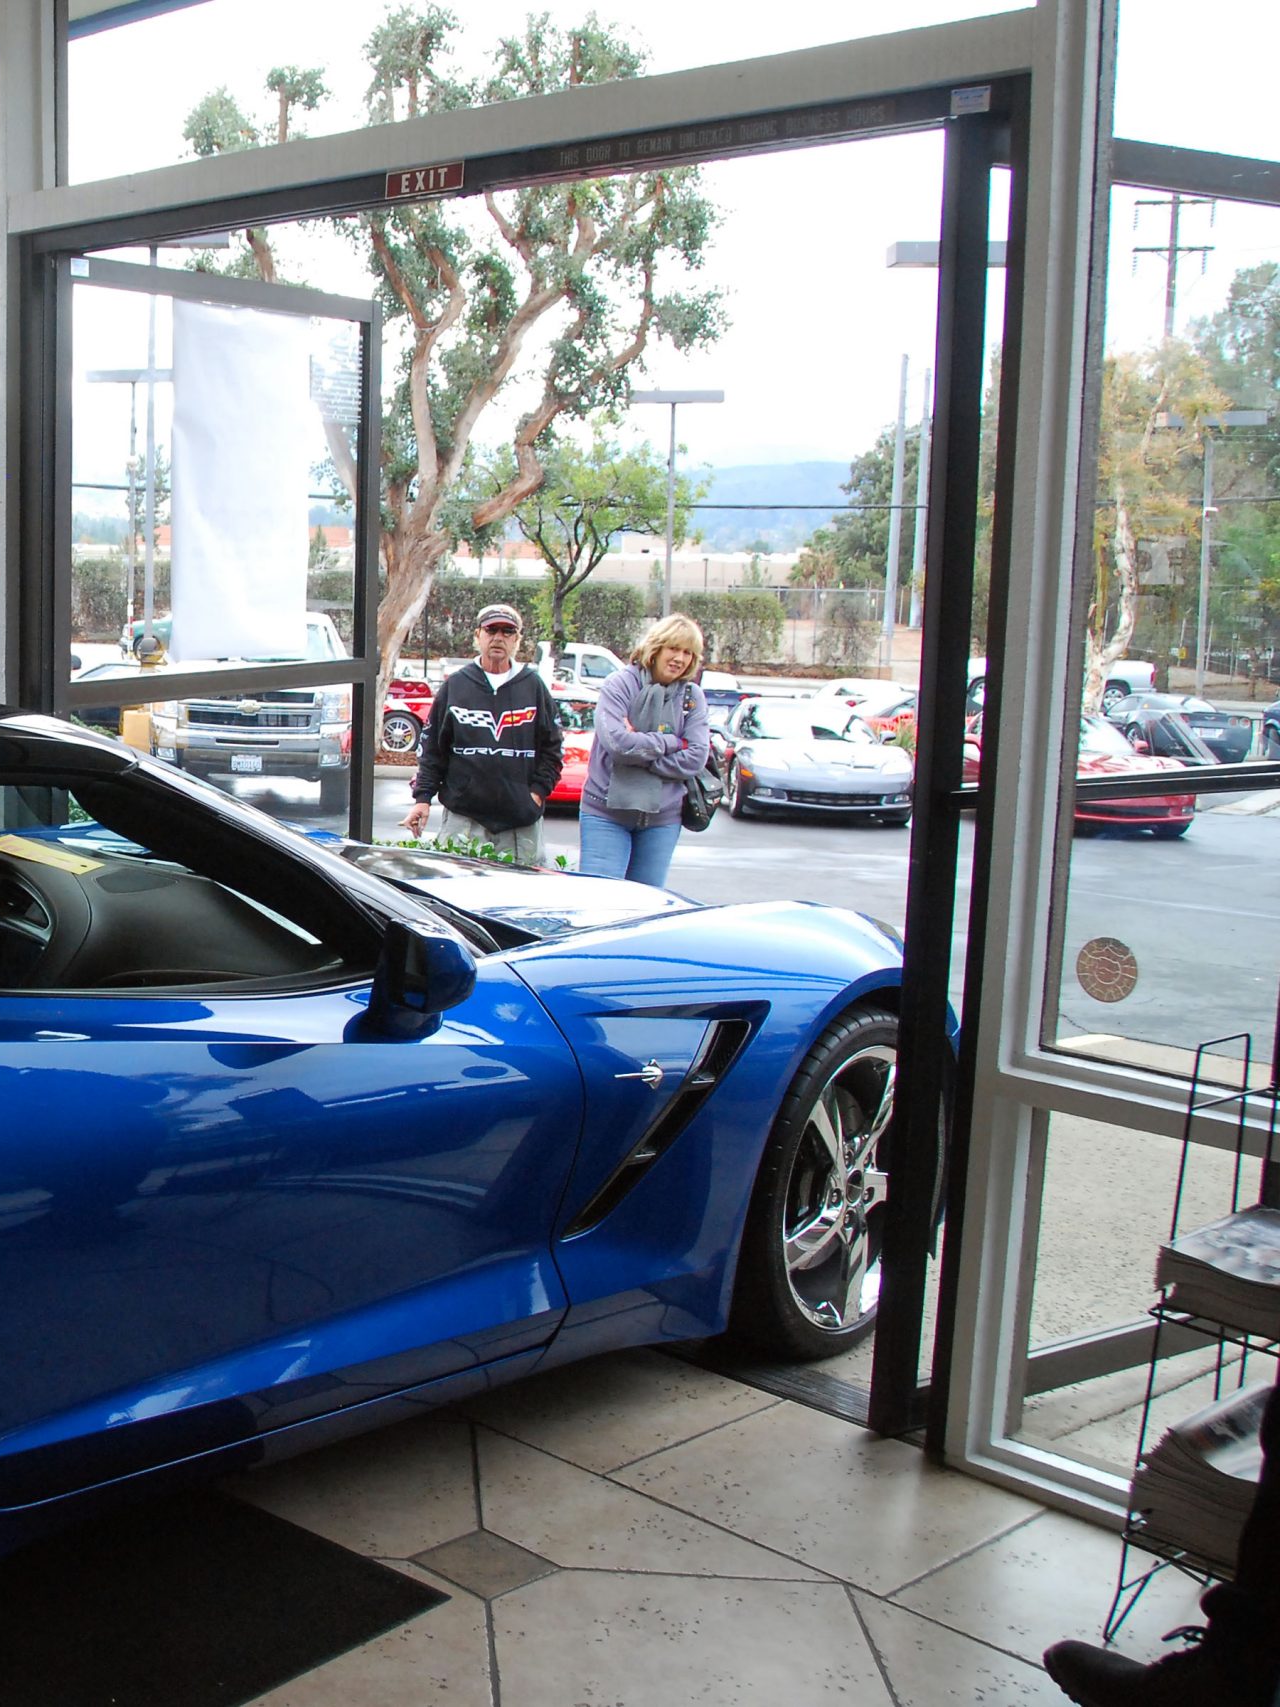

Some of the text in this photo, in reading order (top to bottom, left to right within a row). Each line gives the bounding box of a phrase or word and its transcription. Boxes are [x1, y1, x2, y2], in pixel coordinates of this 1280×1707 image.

[559, 149, 579, 166] THIS
[586, 144, 611, 163] DOOR
[619, 141, 630, 158] TO
[636, 136, 672, 155] REMAIN
[679, 126, 732, 149] UNLOCKED
[400, 167, 449, 194] EXIT
[452, 746, 536, 758] CORVETTE
